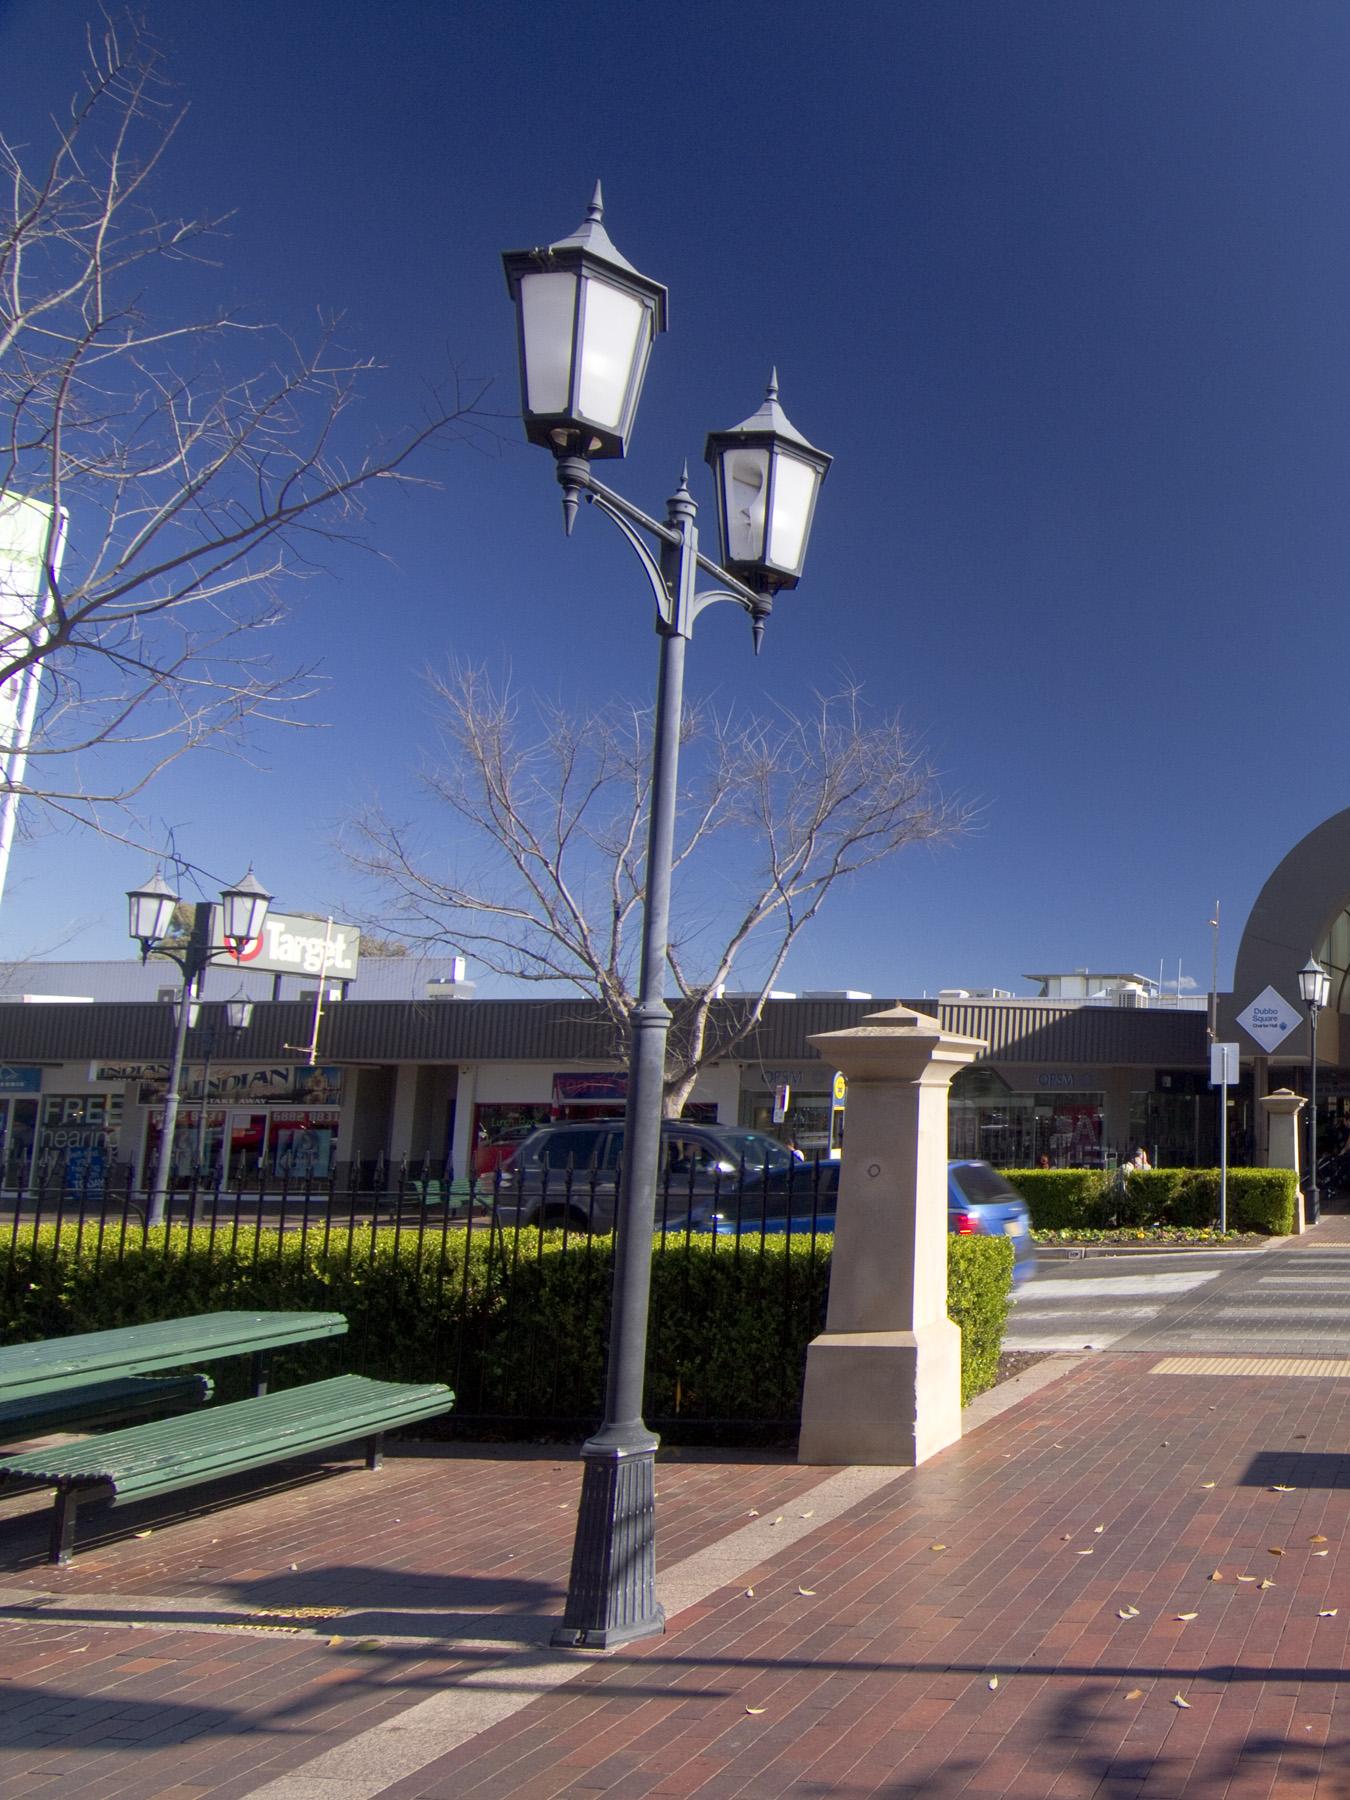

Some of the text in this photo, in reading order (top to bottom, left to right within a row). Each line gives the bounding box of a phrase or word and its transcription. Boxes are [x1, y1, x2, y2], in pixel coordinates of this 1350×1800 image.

[1252, 1015, 1278, 1023] Square
[1253, 1007, 1278, 1015] Dubbo
[99, 1065, 171, 1078] INDIAN
[193, 1067, 289, 1097] INDIAN
[44, 1097, 123, 1124] FREE
[41, 1126, 119, 1147] hearing
